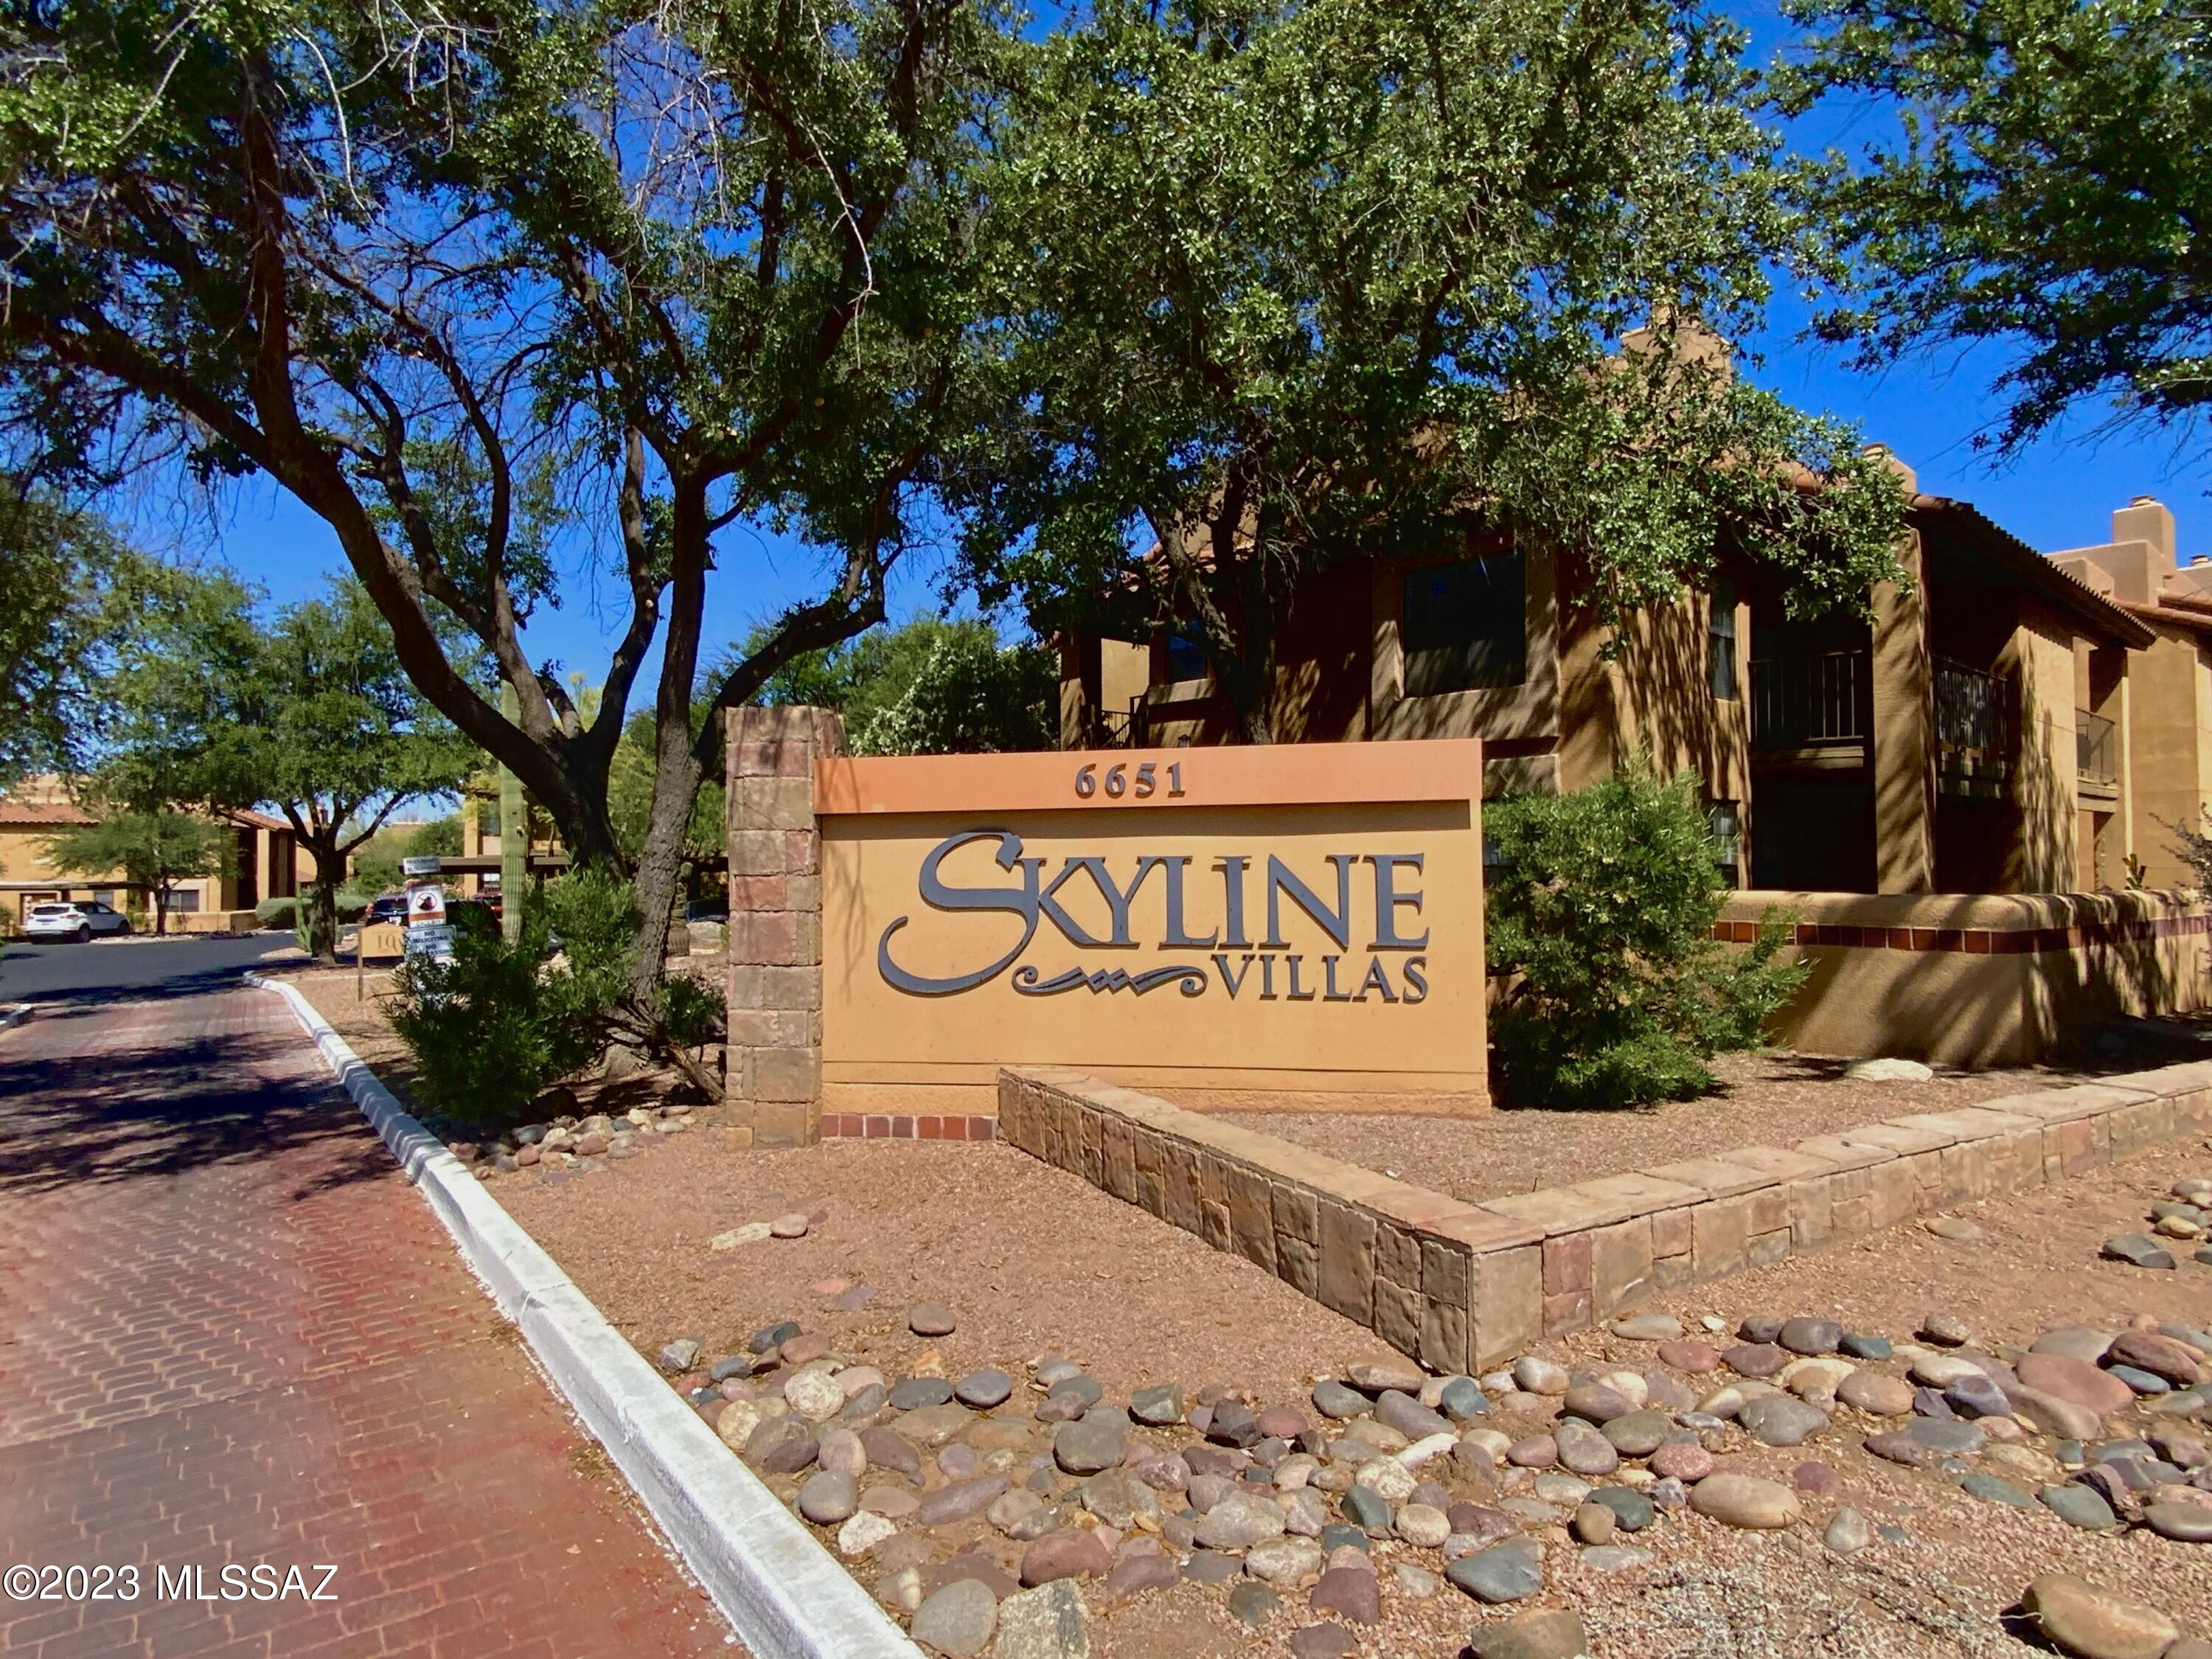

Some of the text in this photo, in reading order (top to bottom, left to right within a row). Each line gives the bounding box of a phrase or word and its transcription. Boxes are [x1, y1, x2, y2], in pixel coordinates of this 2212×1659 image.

[1075, 762, 1186, 799] 6651
[877, 830, 1430, 998] SKYLINE
[1210, 953, 1428, 1004] VILLAS
